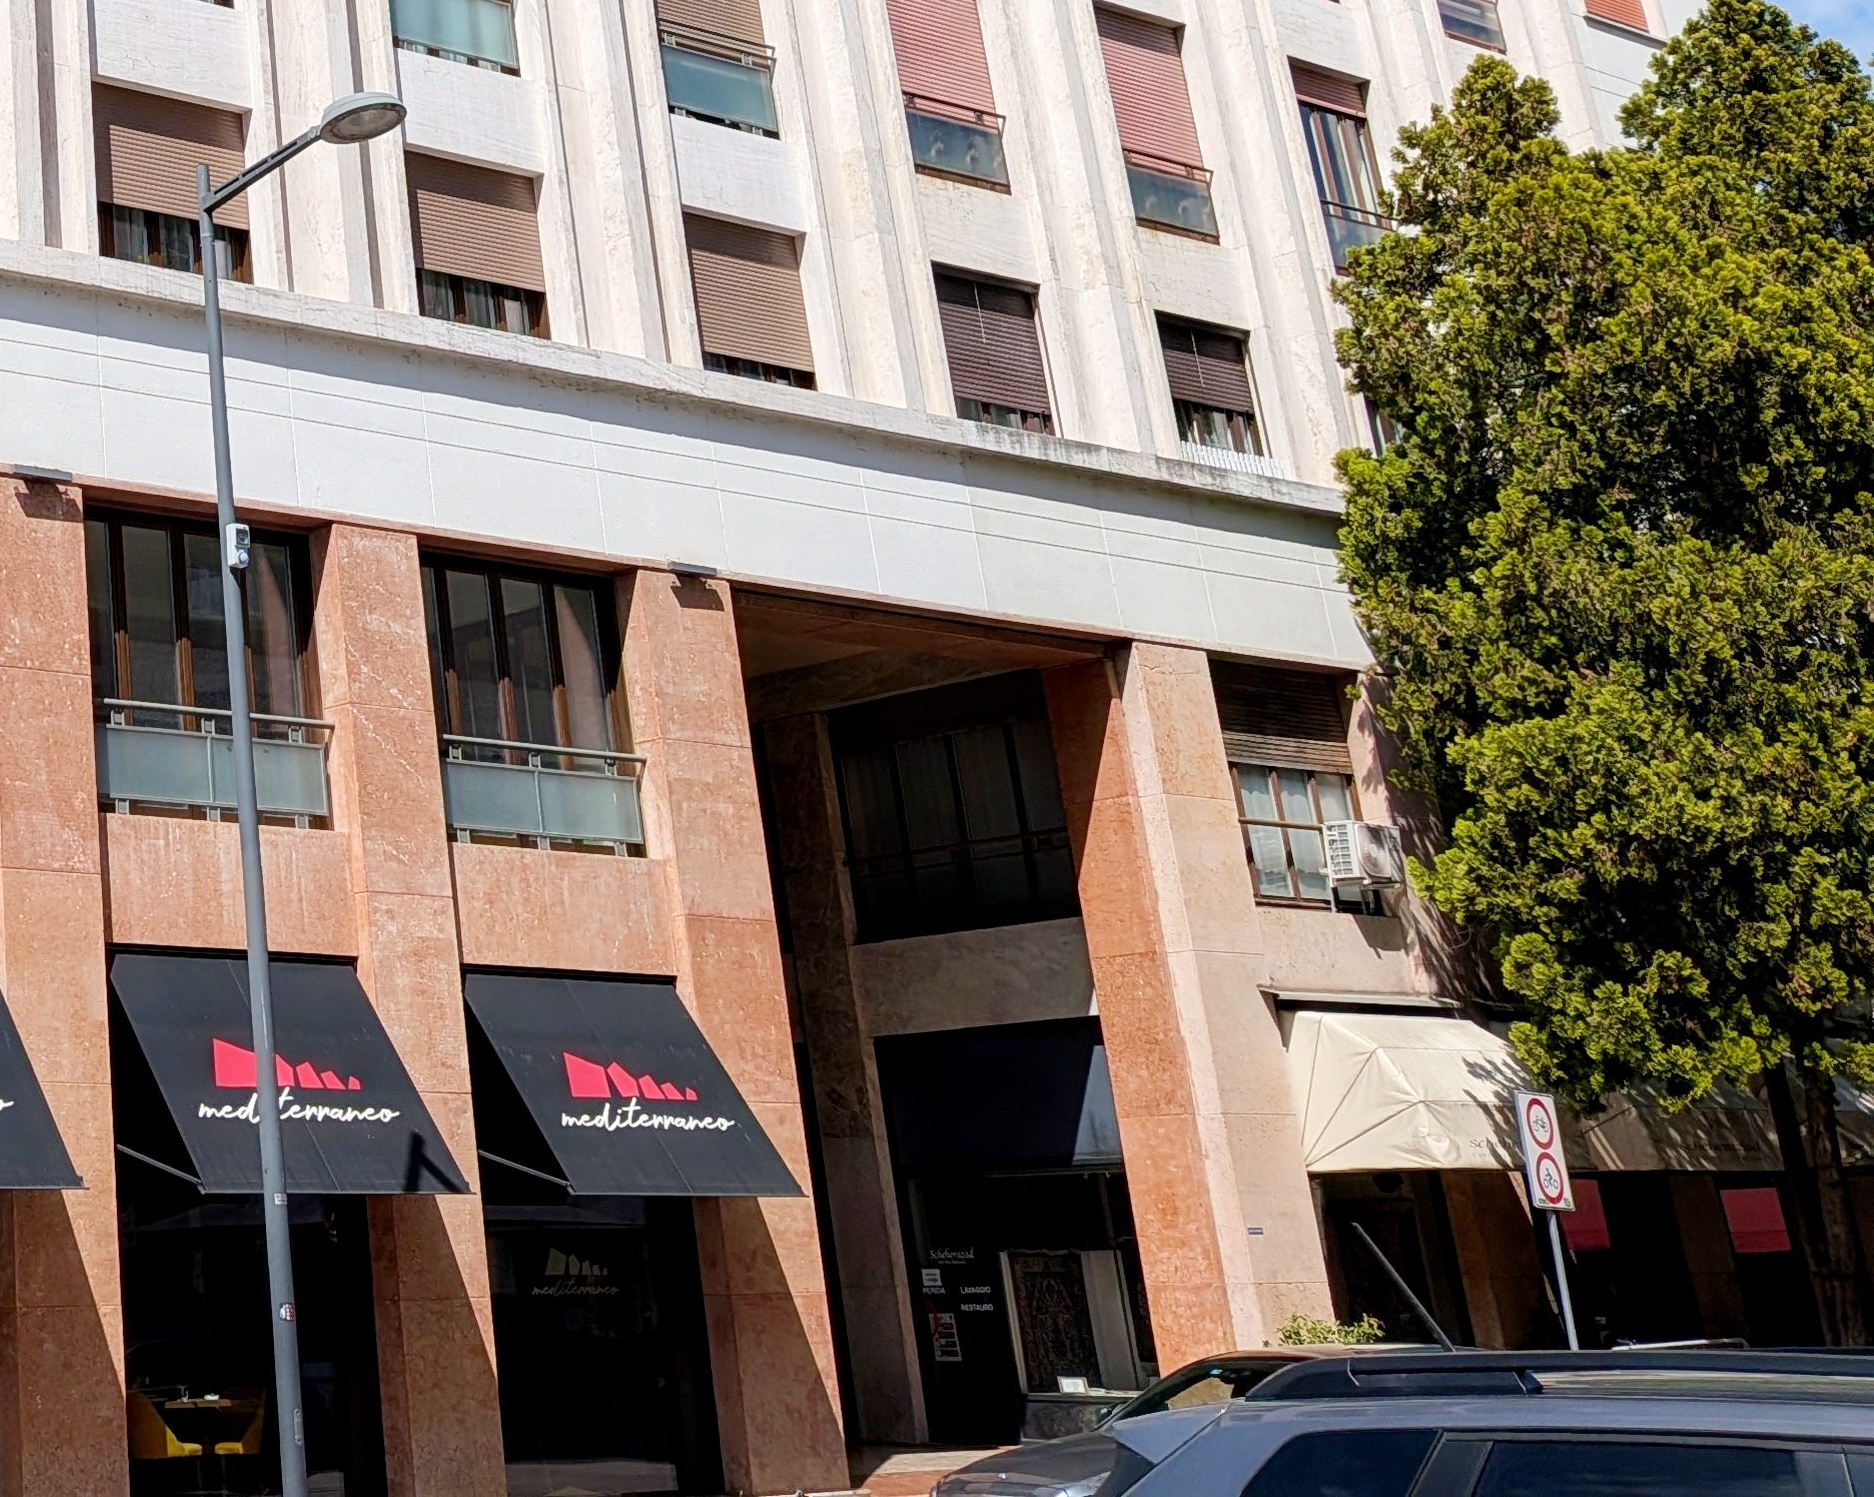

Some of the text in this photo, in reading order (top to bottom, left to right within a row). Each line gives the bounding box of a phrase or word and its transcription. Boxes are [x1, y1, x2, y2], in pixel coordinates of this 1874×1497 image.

[198, 1086, 400, 1124] medterraneo
[561, 1097, 736, 1132] mediterraneo
[531, 1276, 620, 1297] mediterraneo
